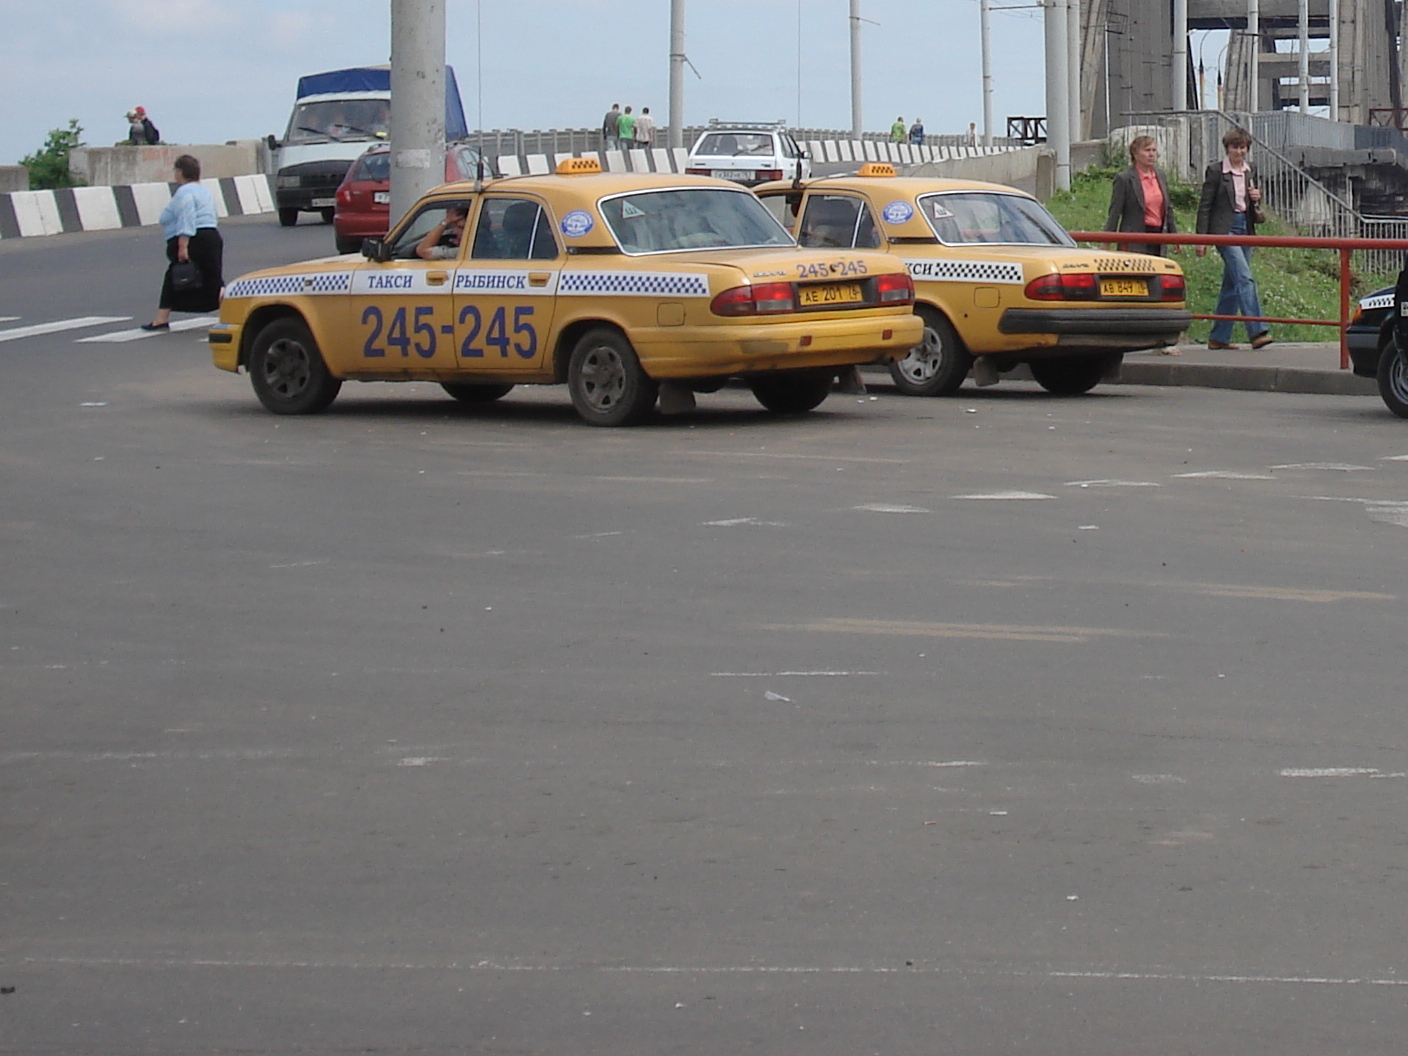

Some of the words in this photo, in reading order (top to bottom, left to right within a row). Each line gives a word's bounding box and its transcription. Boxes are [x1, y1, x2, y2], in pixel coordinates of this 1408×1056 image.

[368, 275, 413, 288] ТАКСИ
[456, 275, 527, 289] РЫБИНСК
[361, 305, 537, 359] 245-245
